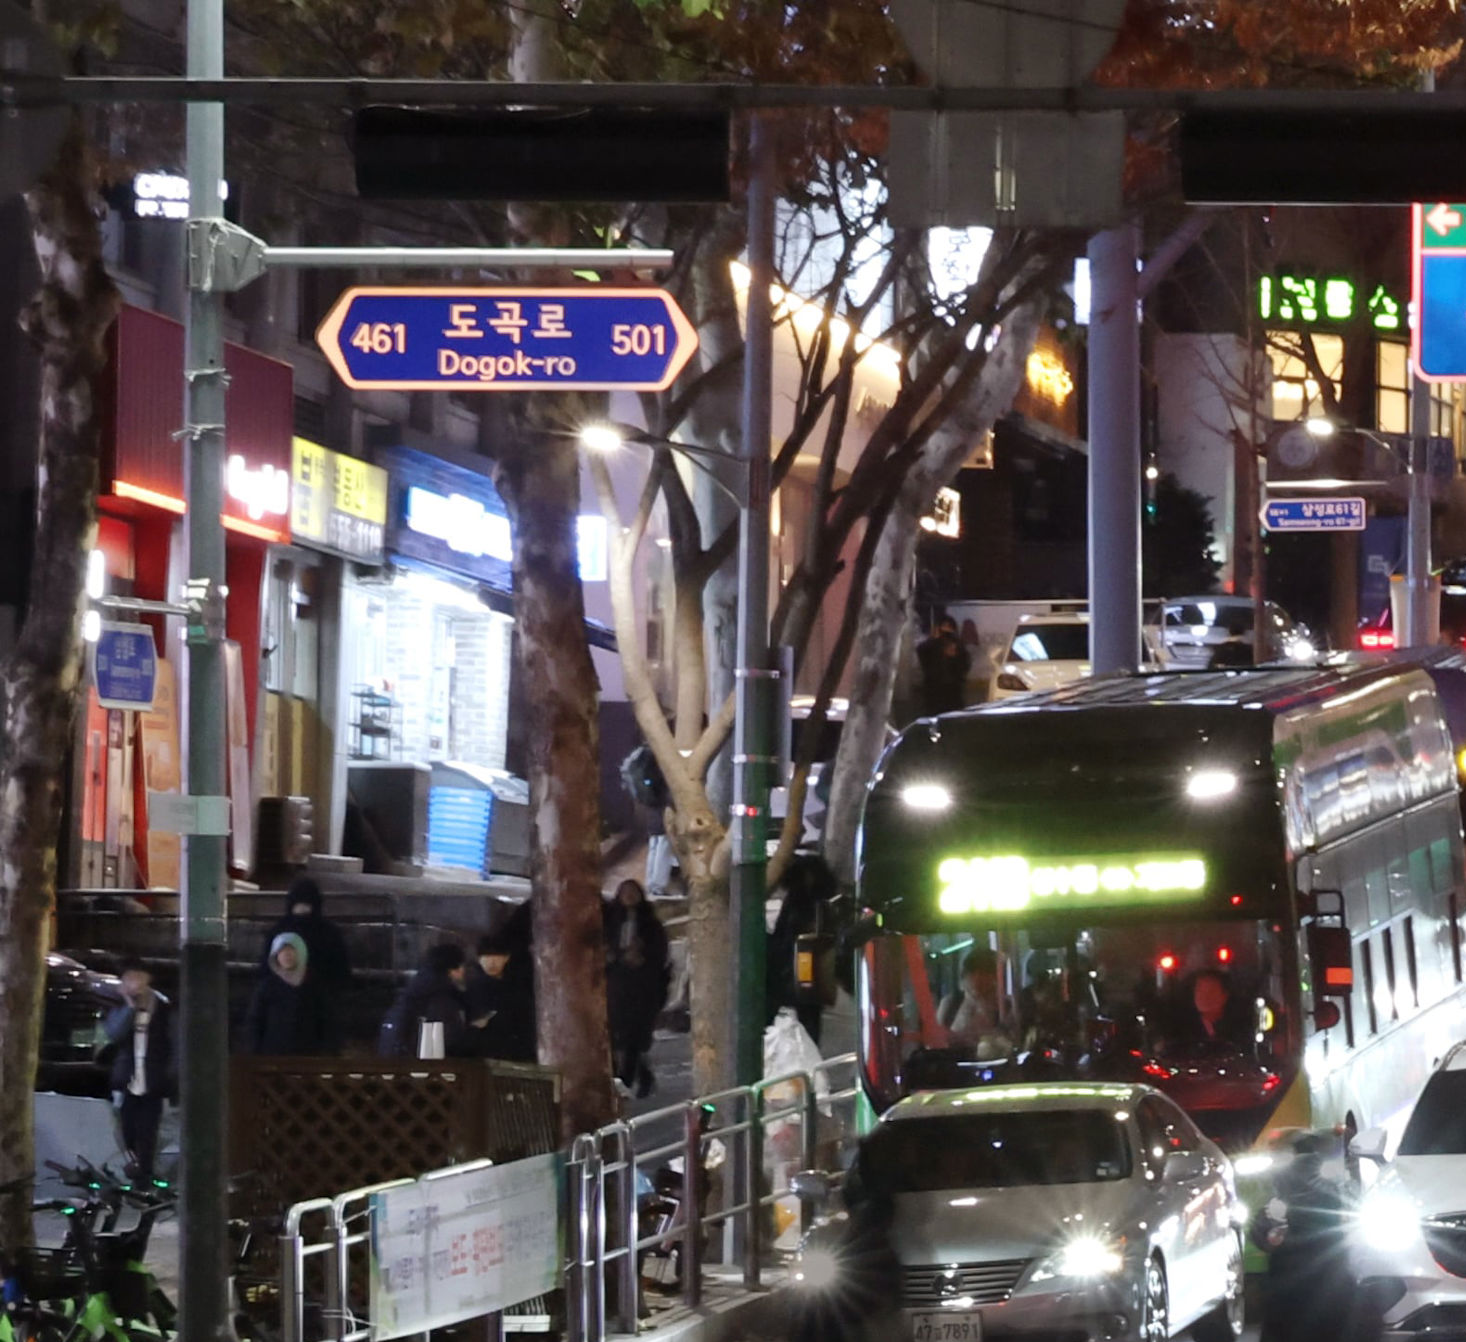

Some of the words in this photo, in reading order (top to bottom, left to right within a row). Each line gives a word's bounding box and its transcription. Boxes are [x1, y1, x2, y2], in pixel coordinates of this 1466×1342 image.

[351, 322, 407, 354] 461
[442, 302, 573, 344] 도곡로
[611, 324, 665, 356] 501
[437, 349, 577, 382] Dogok-ro
